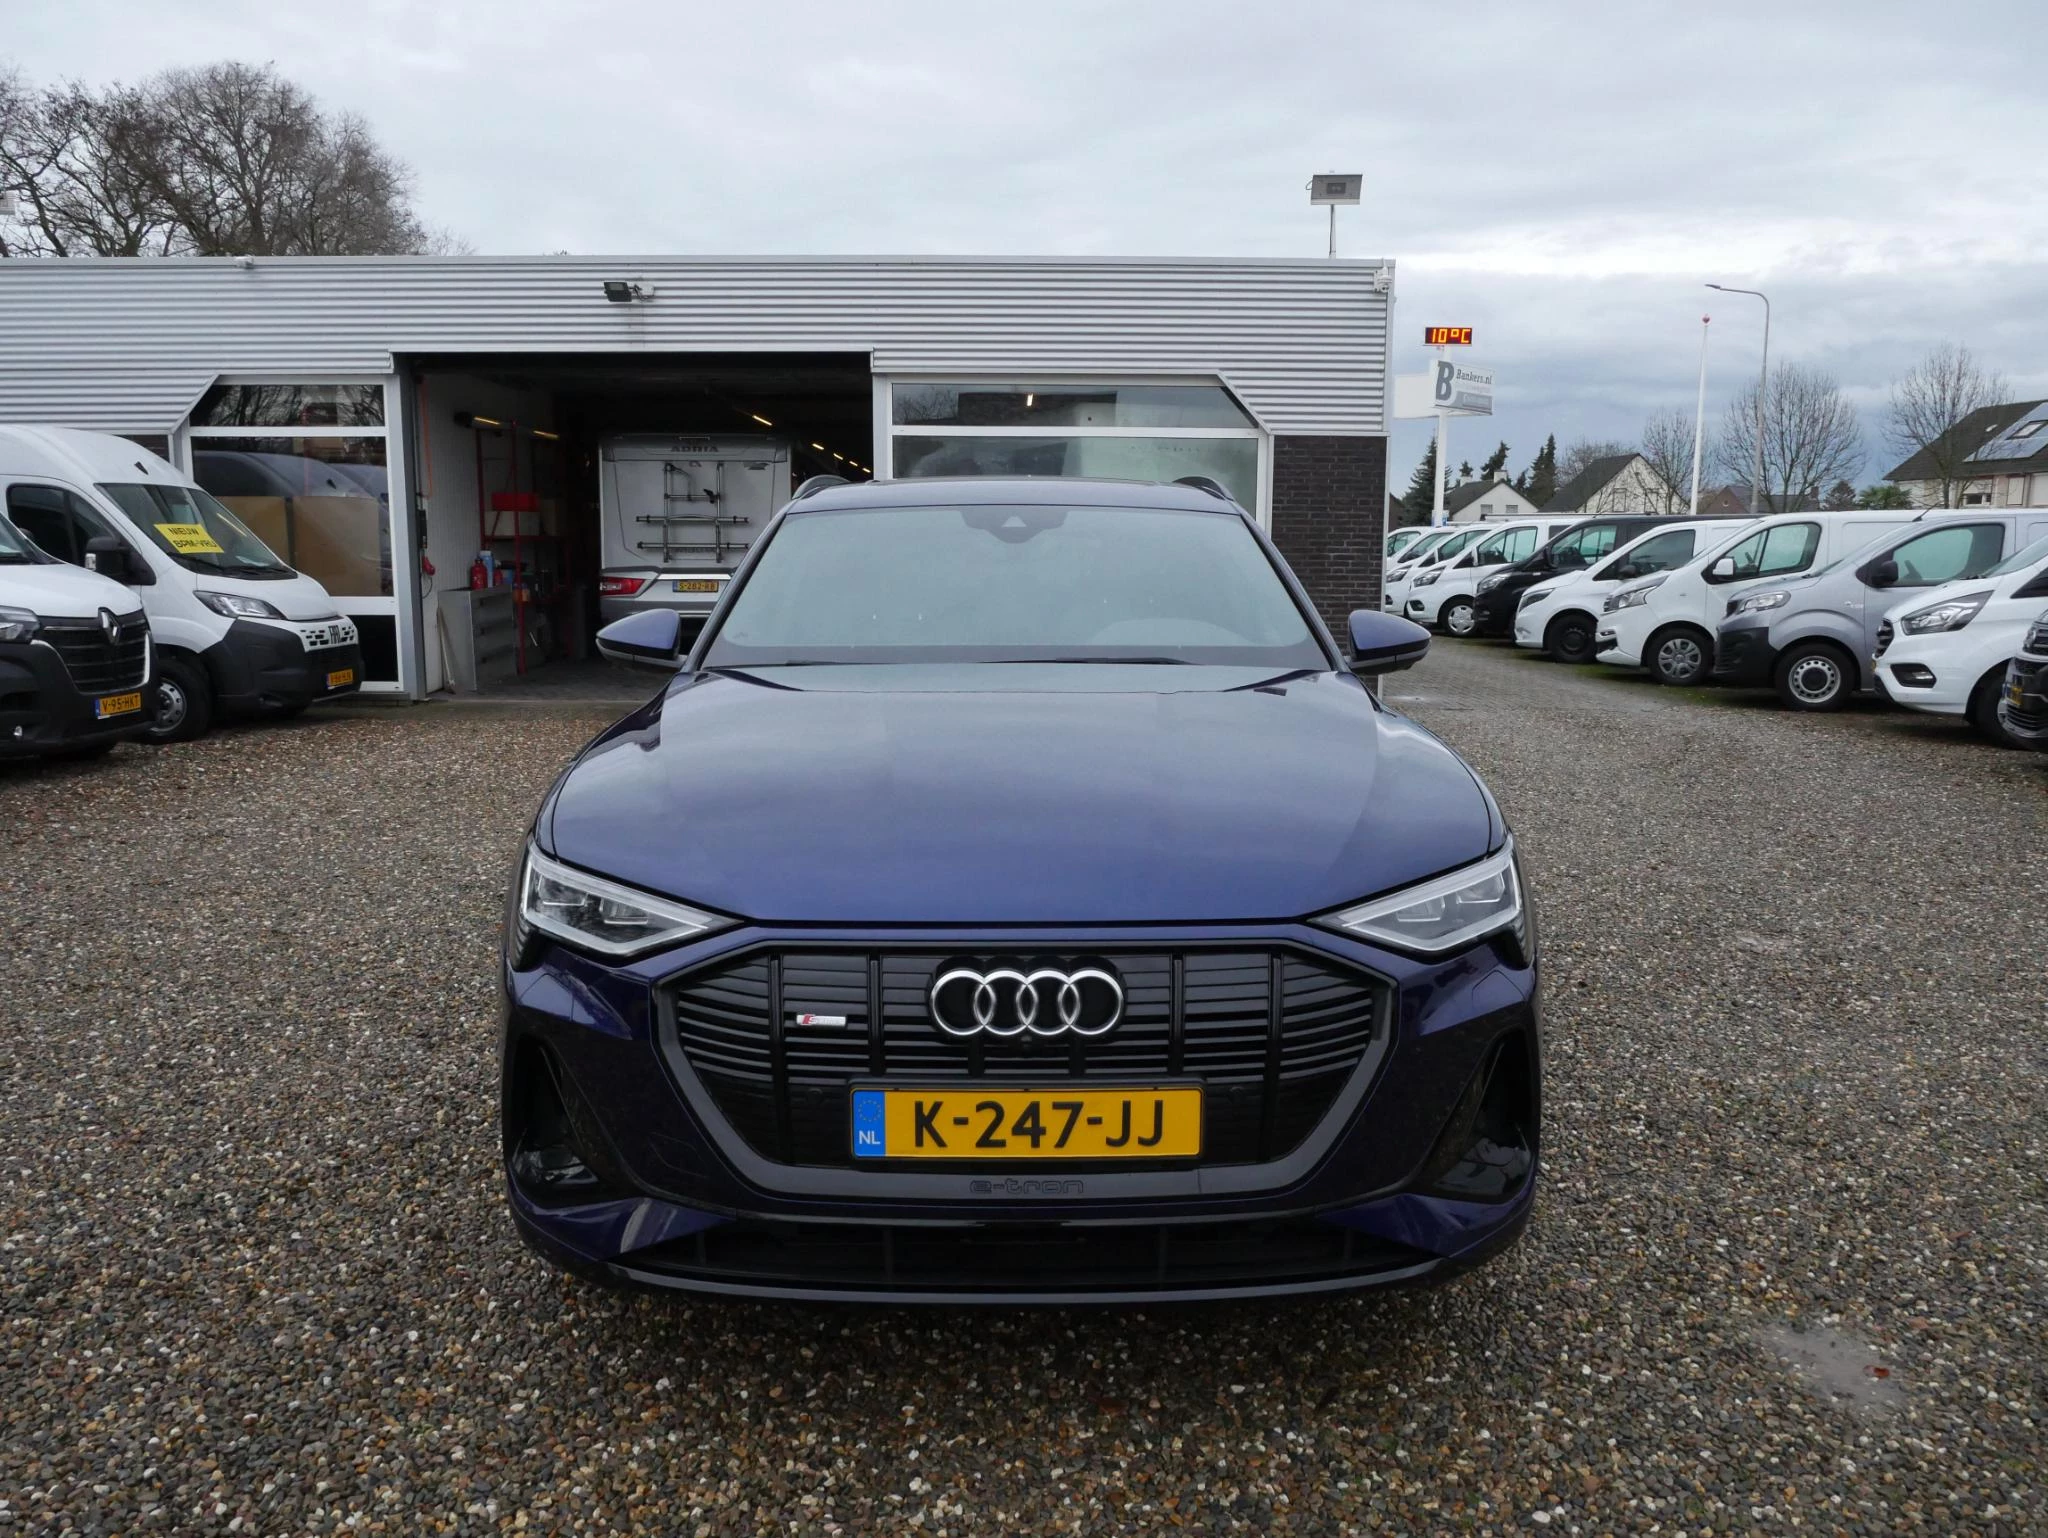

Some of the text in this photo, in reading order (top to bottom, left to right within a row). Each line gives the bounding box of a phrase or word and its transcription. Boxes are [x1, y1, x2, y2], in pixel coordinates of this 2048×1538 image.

[1432, 328, 1471, 344] 10°C
[167, 527, 200, 536] NIEUW
[913, 1100, 1165, 1149] K-247-JJ
[858, 1130, 881, 1146] NL
[969, 1178, 1085, 1195] e-tron
